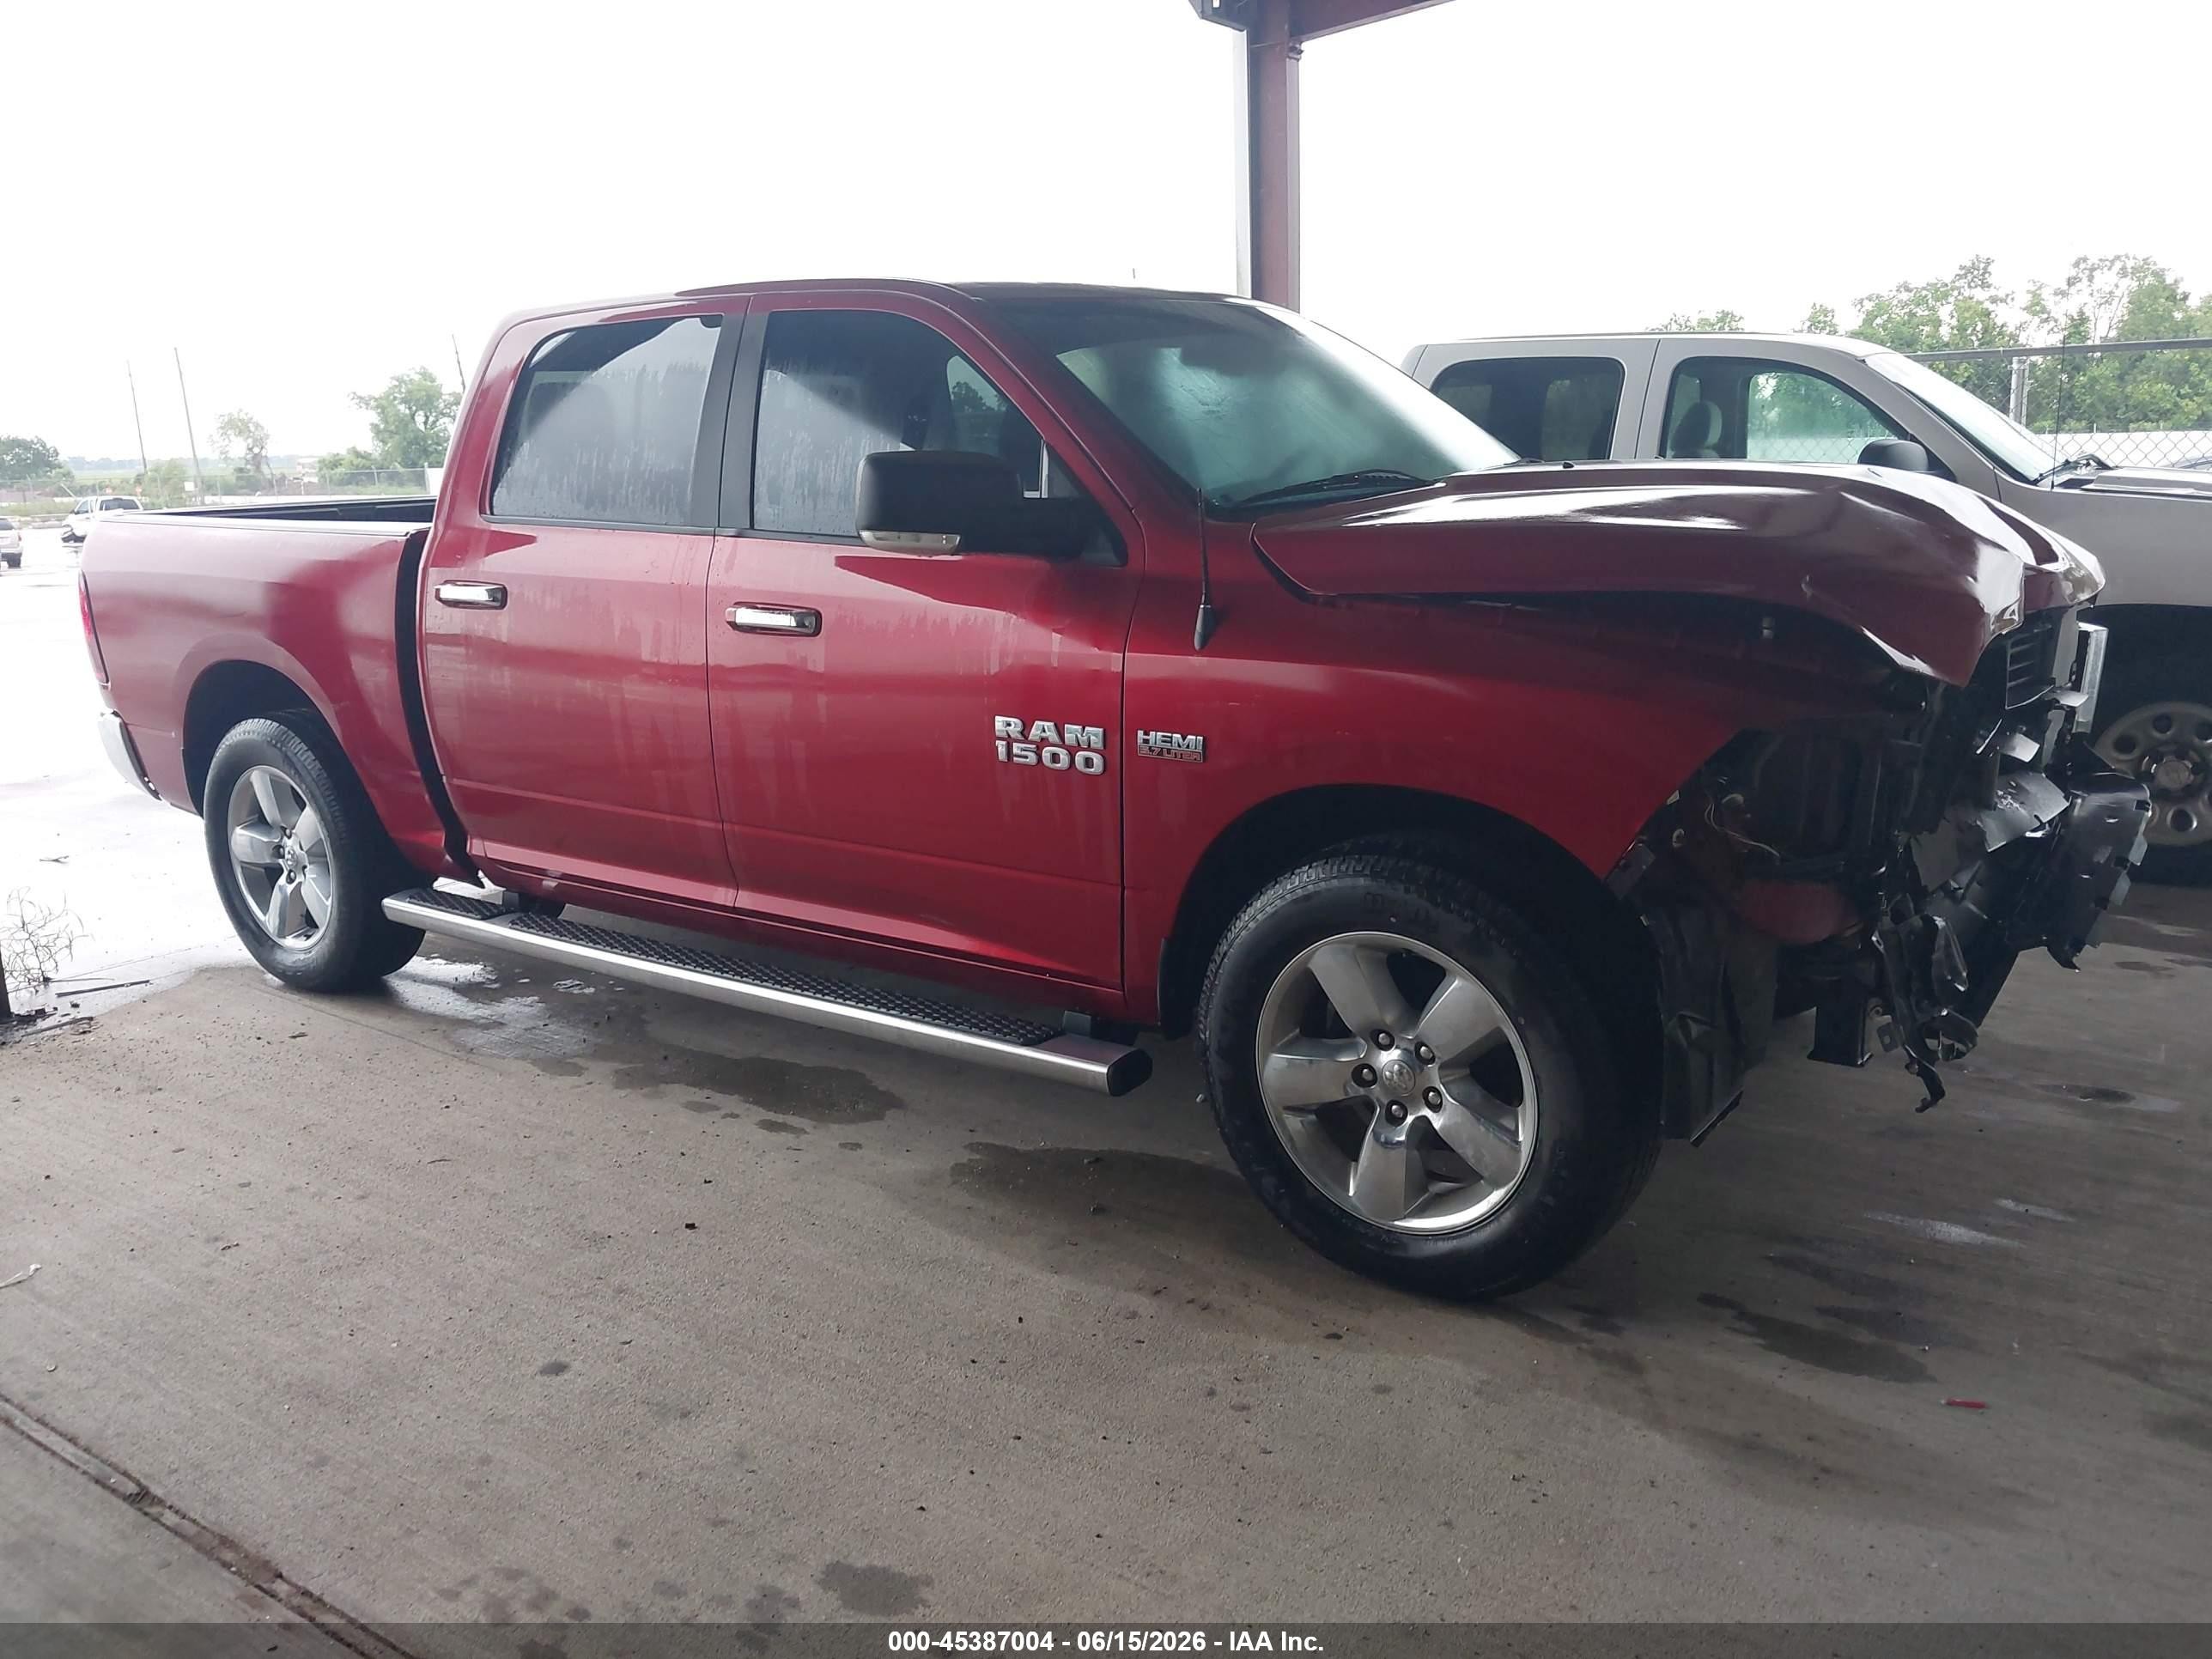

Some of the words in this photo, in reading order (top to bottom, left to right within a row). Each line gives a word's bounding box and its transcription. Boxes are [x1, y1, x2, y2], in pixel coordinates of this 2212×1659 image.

[994, 715, 1104, 750] RAM
[1137, 730, 1203, 750] HEMI
[995, 740, 1104, 775] 1500
[1139, 745, 1161, 756] 5.7
[1163, 748, 1200, 761] LITER
